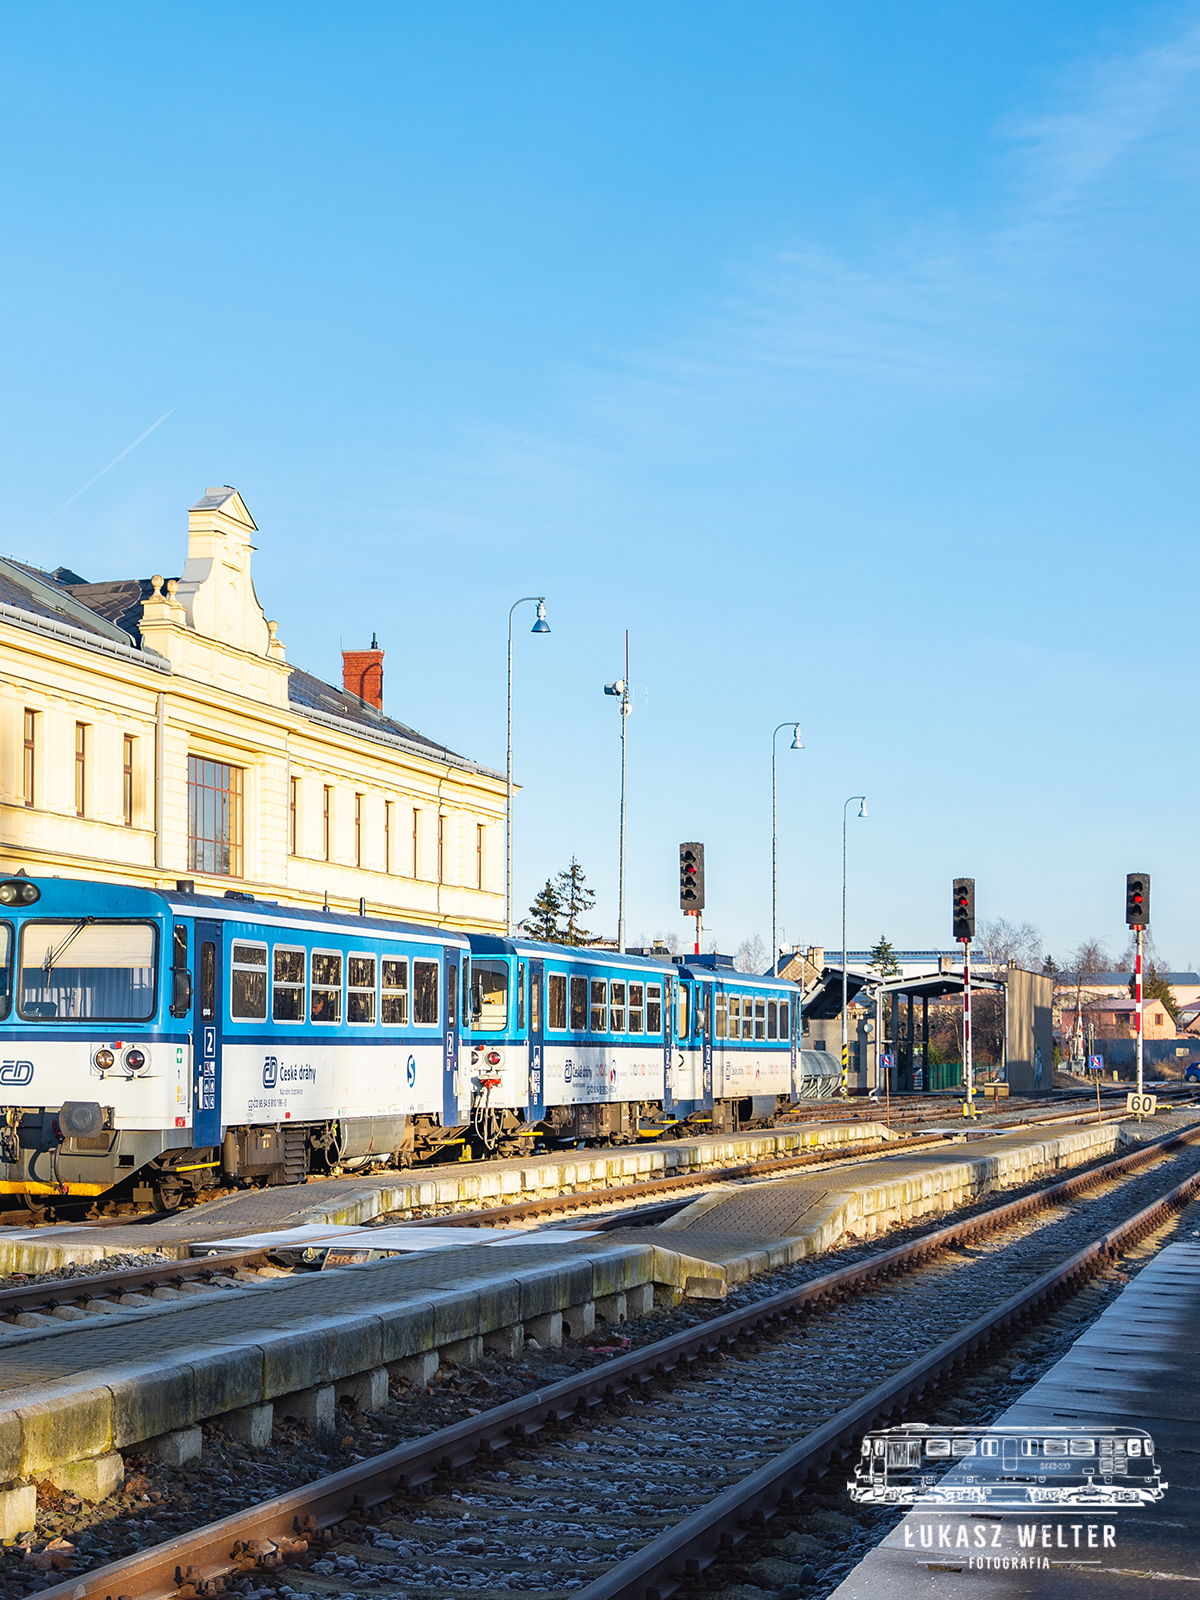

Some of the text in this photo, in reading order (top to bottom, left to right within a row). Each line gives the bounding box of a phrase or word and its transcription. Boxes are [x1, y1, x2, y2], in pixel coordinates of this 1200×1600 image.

[206, 1031, 213, 1053] 2
[280, 1062, 317, 1084] České dráhy
[1131, 1095, 1152, 1112] 60
